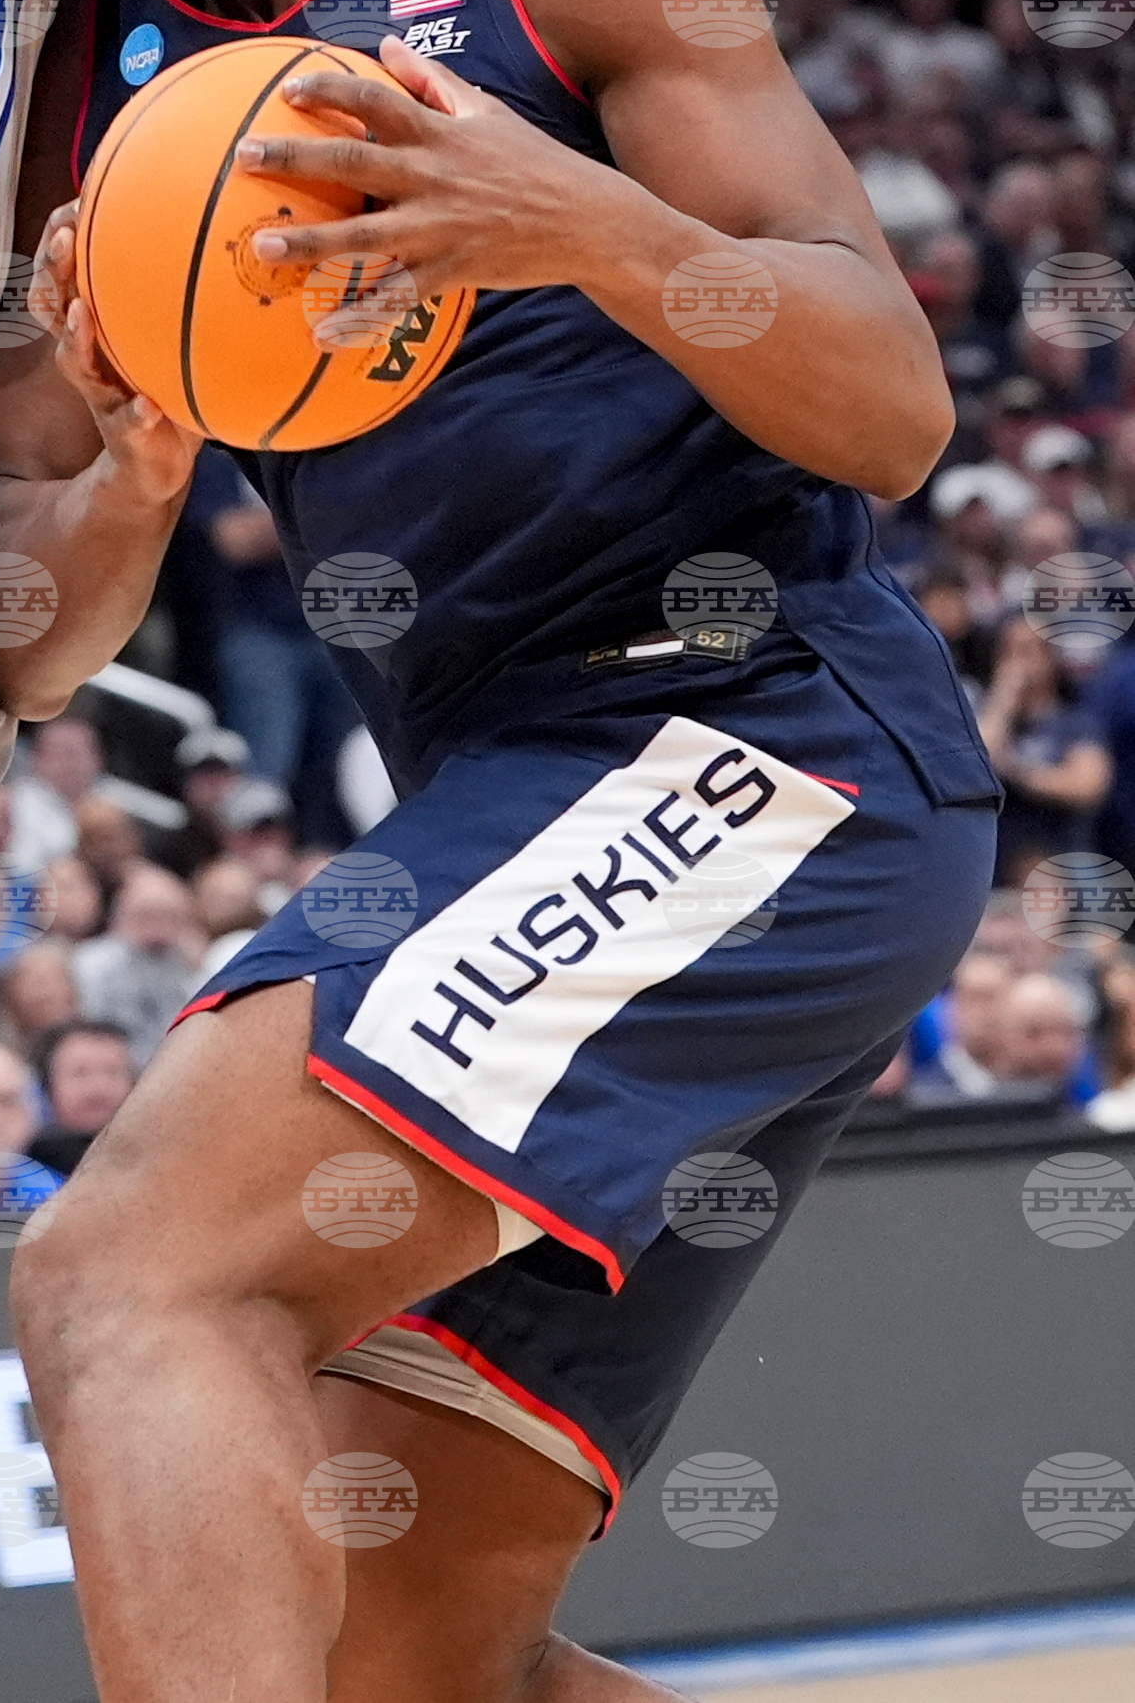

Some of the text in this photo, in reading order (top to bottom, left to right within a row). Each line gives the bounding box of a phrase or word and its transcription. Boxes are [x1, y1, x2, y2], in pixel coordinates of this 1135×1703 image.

[404, 16, 457, 39] BIG
[125, 48, 160, 74] NCAA
[697, 630, 727, 649] 52
[410, 748, 777, 1071] HUSKIES
